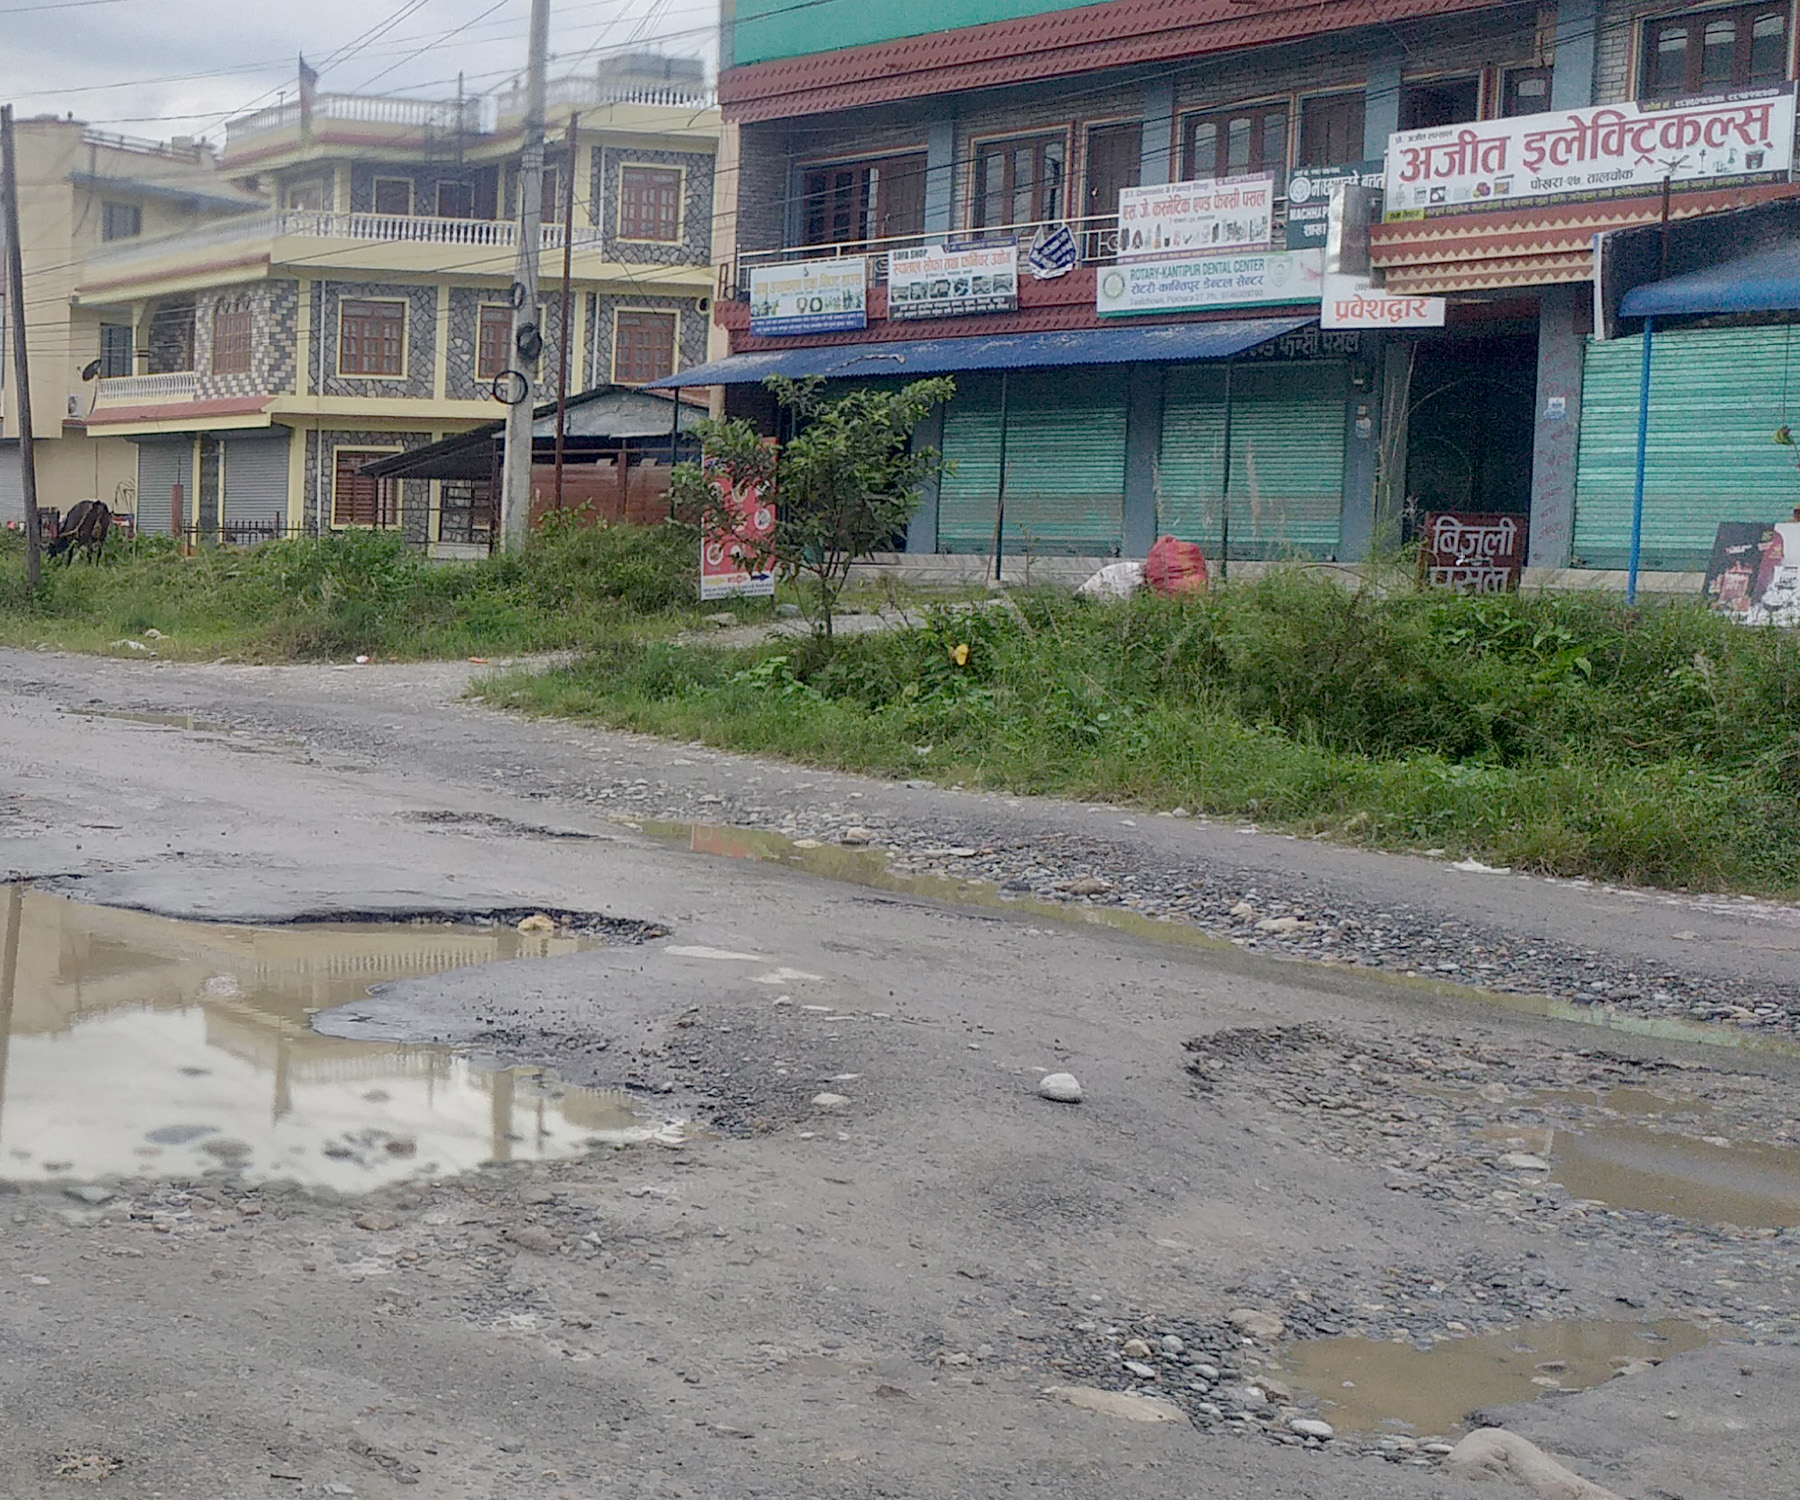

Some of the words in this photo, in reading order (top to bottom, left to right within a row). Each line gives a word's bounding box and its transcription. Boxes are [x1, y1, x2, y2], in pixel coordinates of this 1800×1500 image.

[1399, 129, 1512, 182] अजीत
[1130, 263, 1200, 281] ROTARY-KANTIPUR
[1202, 260, 1232, 276] DENTAL
[1234, 258, 1265, 273] CENTER
[1335, 294, 1431, 323] प्रवेशद्वार
